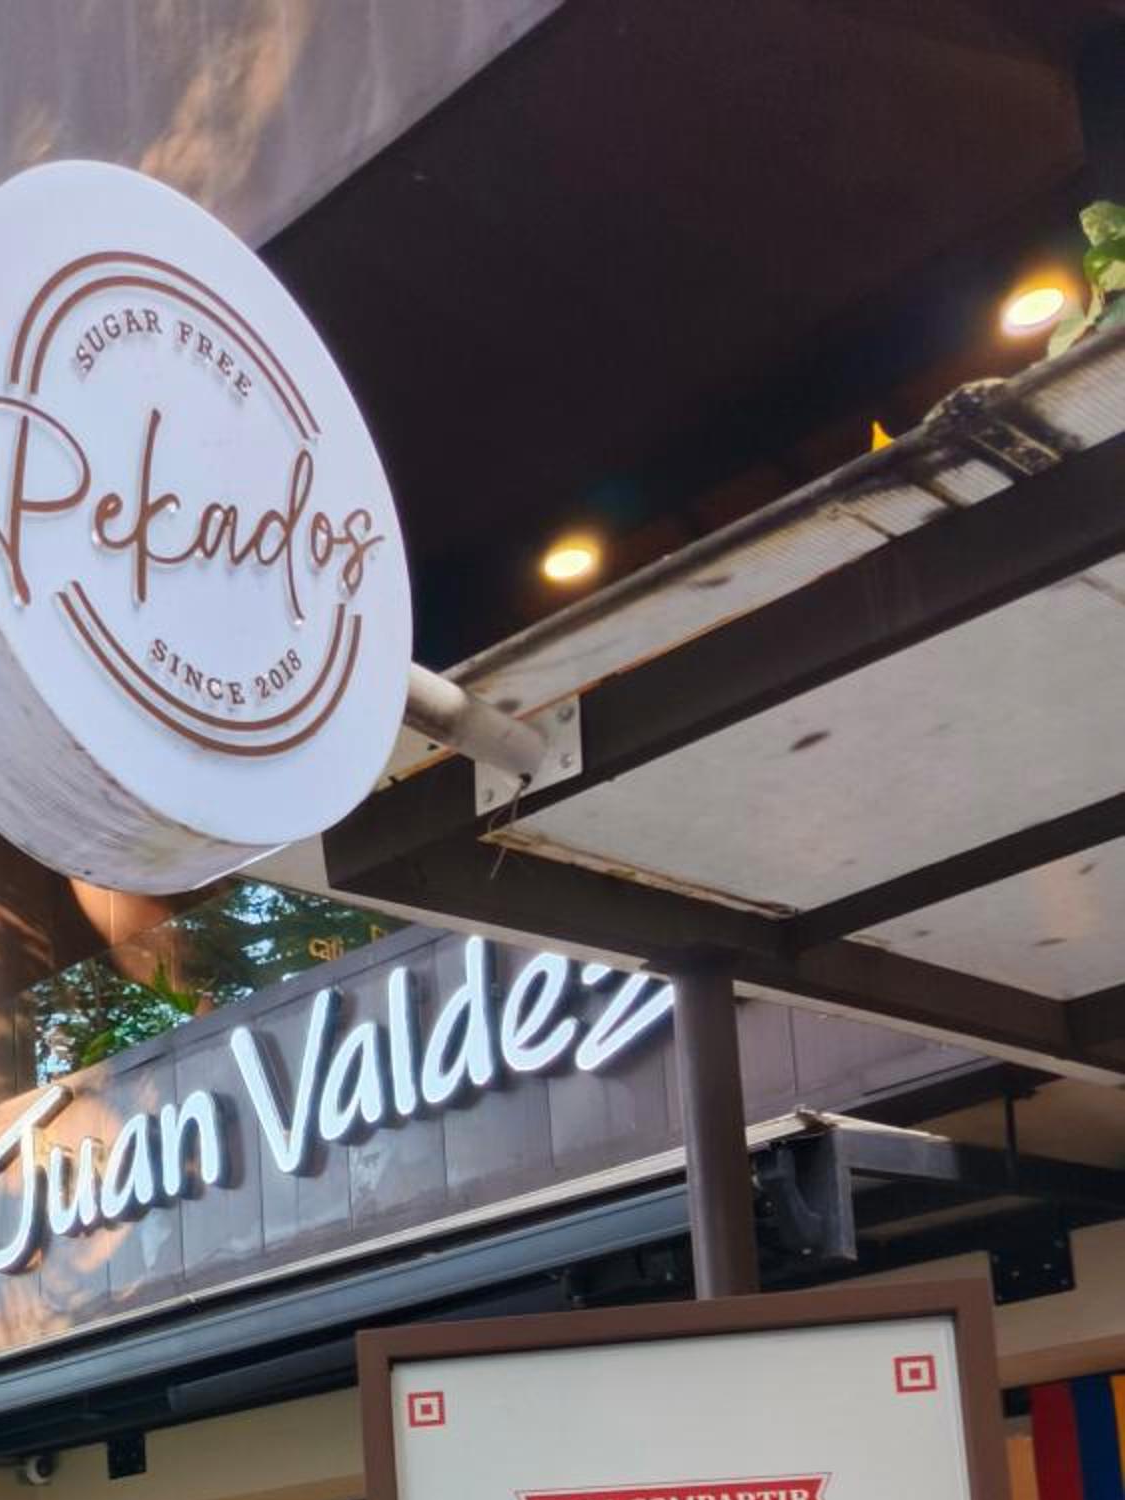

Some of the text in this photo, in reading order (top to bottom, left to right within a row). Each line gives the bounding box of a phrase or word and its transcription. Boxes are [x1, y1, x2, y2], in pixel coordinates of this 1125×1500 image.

[75, 306, 254, 400] SUGAR FREE
[149, 636, 305, 706] SINCE 2018
[230, 933, 677, 1175] Valdez
